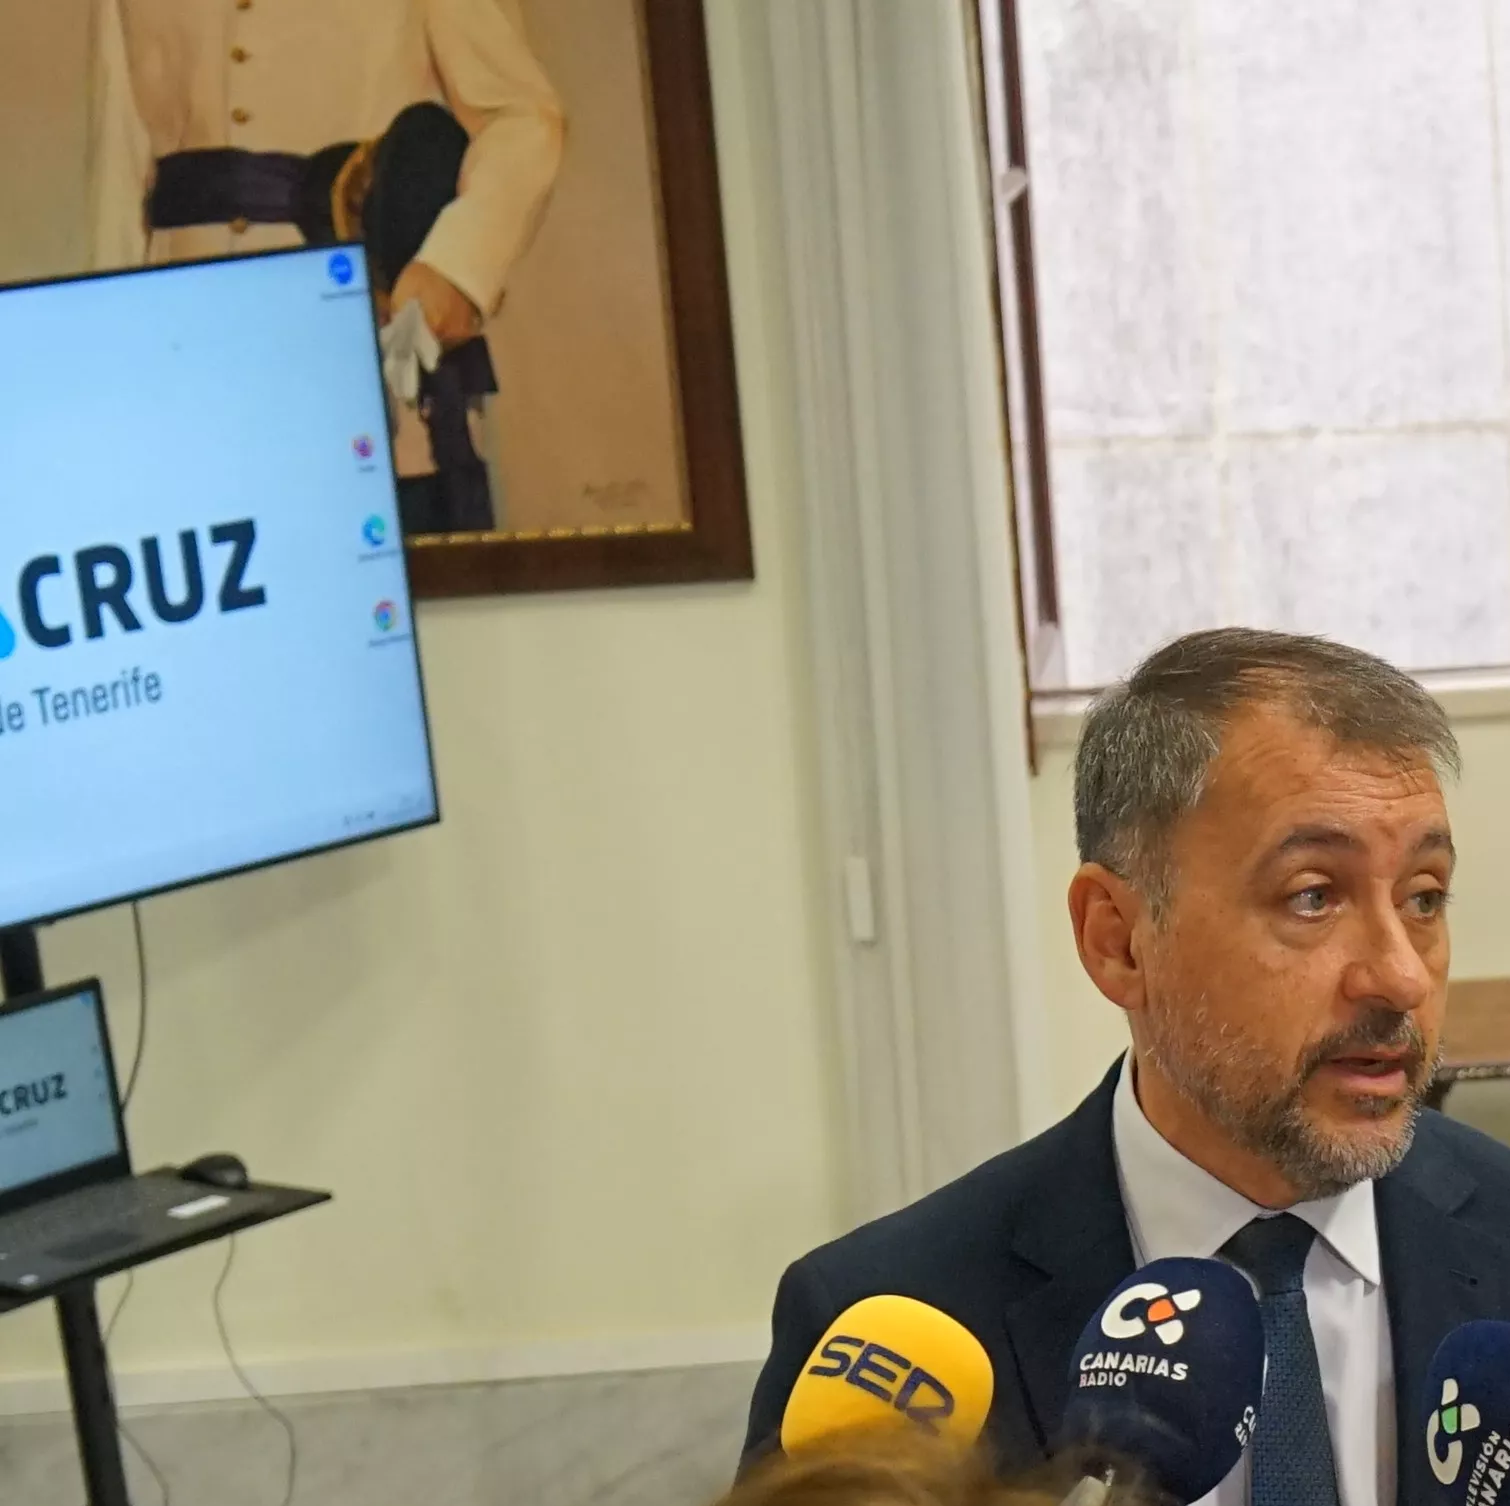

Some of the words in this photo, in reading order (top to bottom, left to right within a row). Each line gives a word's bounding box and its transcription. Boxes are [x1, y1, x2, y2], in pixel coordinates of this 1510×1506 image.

[18, 516, 267, 649] CRUZ
[31, 666, 162, 727] Tenerife
[0, 1071, 68, 1117] CRUZ
[1079, 1352, 1189, 1381] CANARIAS
[1079, 1371, 1127, 1388] RADIO
